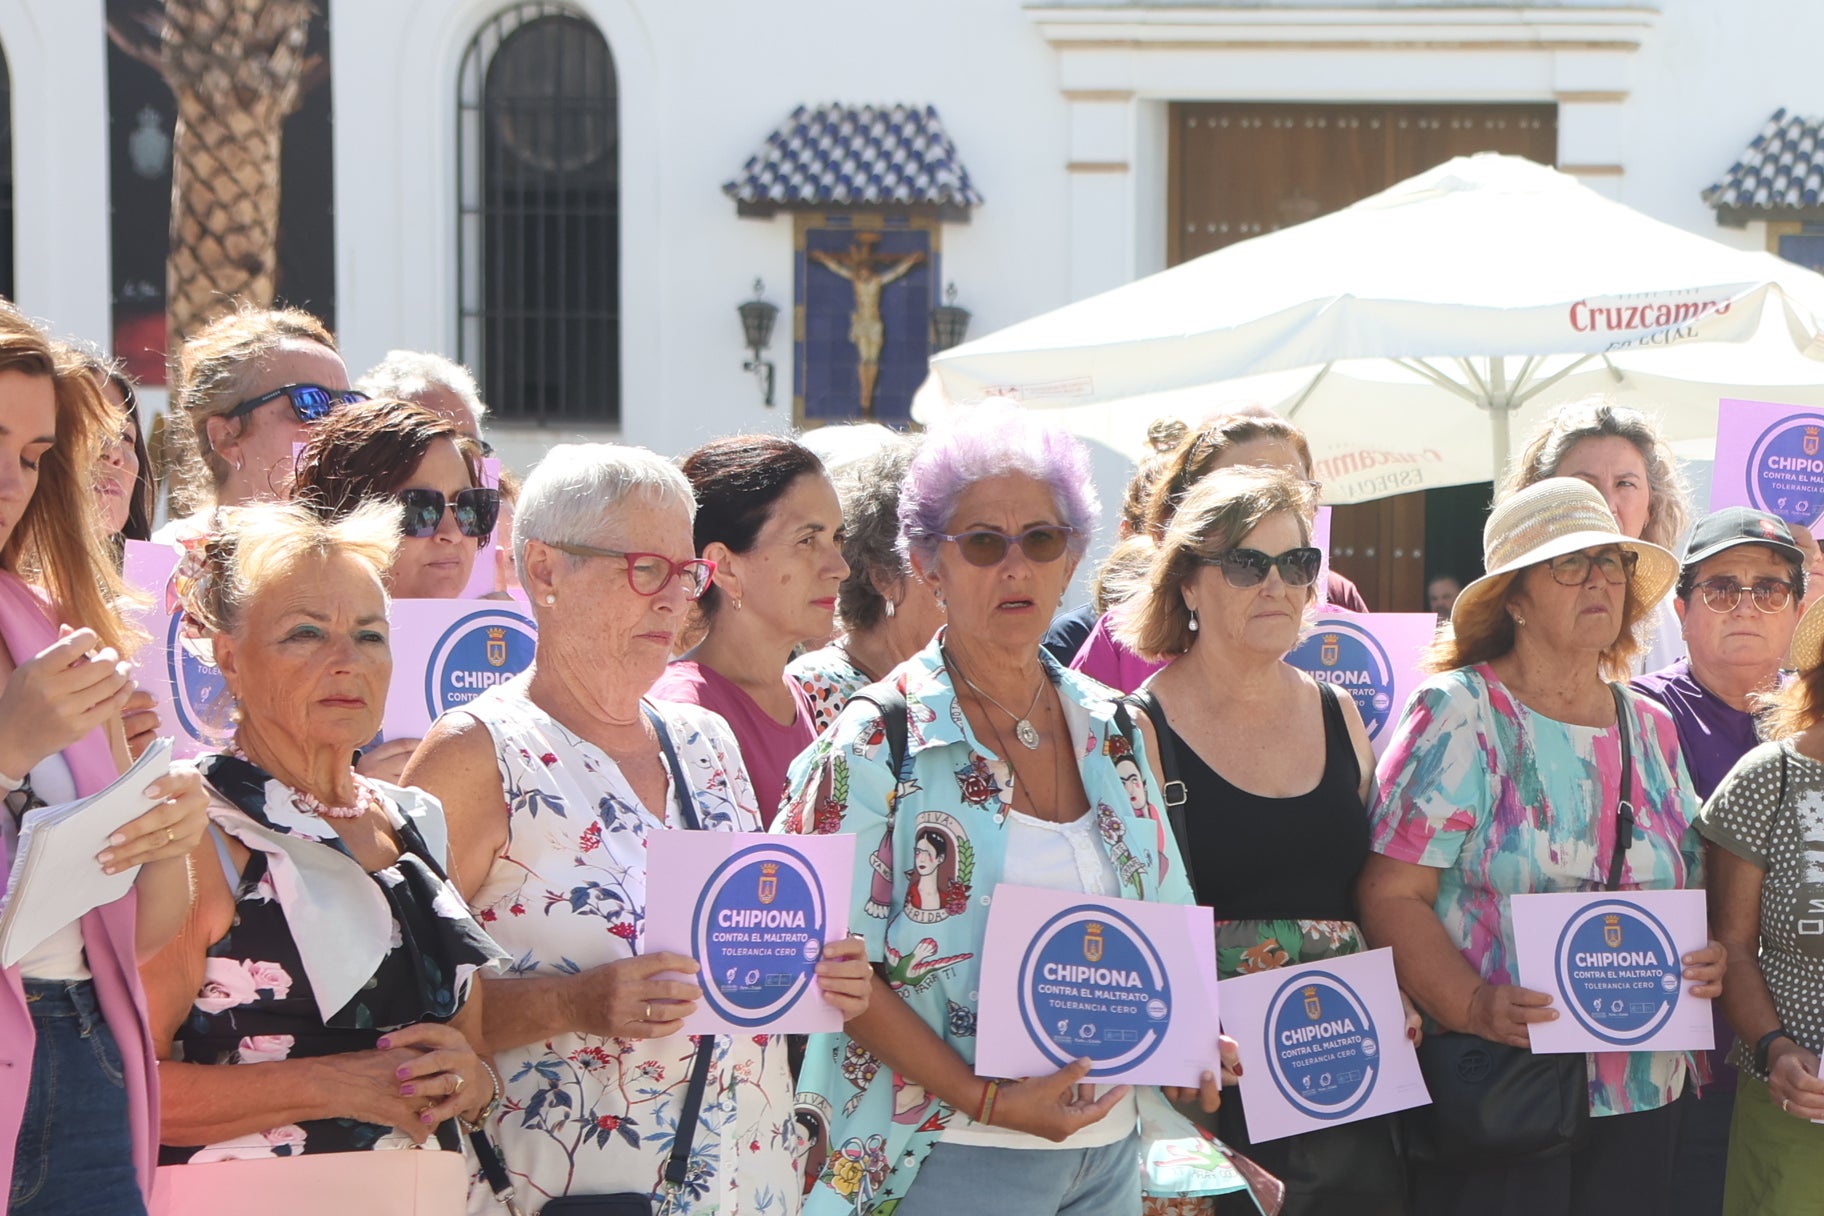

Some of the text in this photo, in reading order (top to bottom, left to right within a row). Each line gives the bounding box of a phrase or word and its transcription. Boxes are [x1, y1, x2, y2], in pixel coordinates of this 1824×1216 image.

[1569, 298, 1732, 333] Cruzcampo
[1763, 472, 1796, 481] CONTRA
[1772, 483, 1817, 492] TOLERANCIA
[1348, 688, 1375, 696] TRATO
[718, 909, 805, 928] CHIPIONA
[713, 933, 808, 942] CONTRA EL MALTRATO
[722, 948, 772, 956] TOLERANCIA
[1575, 952, 1657, 967] CHIPIONA
[1044, 963, 1142, 988] CHIPIONA
[1619, 970, 1663, 978] MALTRATO
[1038, 985, 1149, 1002] CONTRA EL MALTRATO
[1049, 1000, 1137, 1014] TOLERANCIA CERO
[1282, 1018, 1355, 1045] CHIPIONA
[1282, 1036, 1361, 1058] CONTRA EL MALTRATO
[1292, 1050, 1356, 1068] TOLERANCIA CERO
